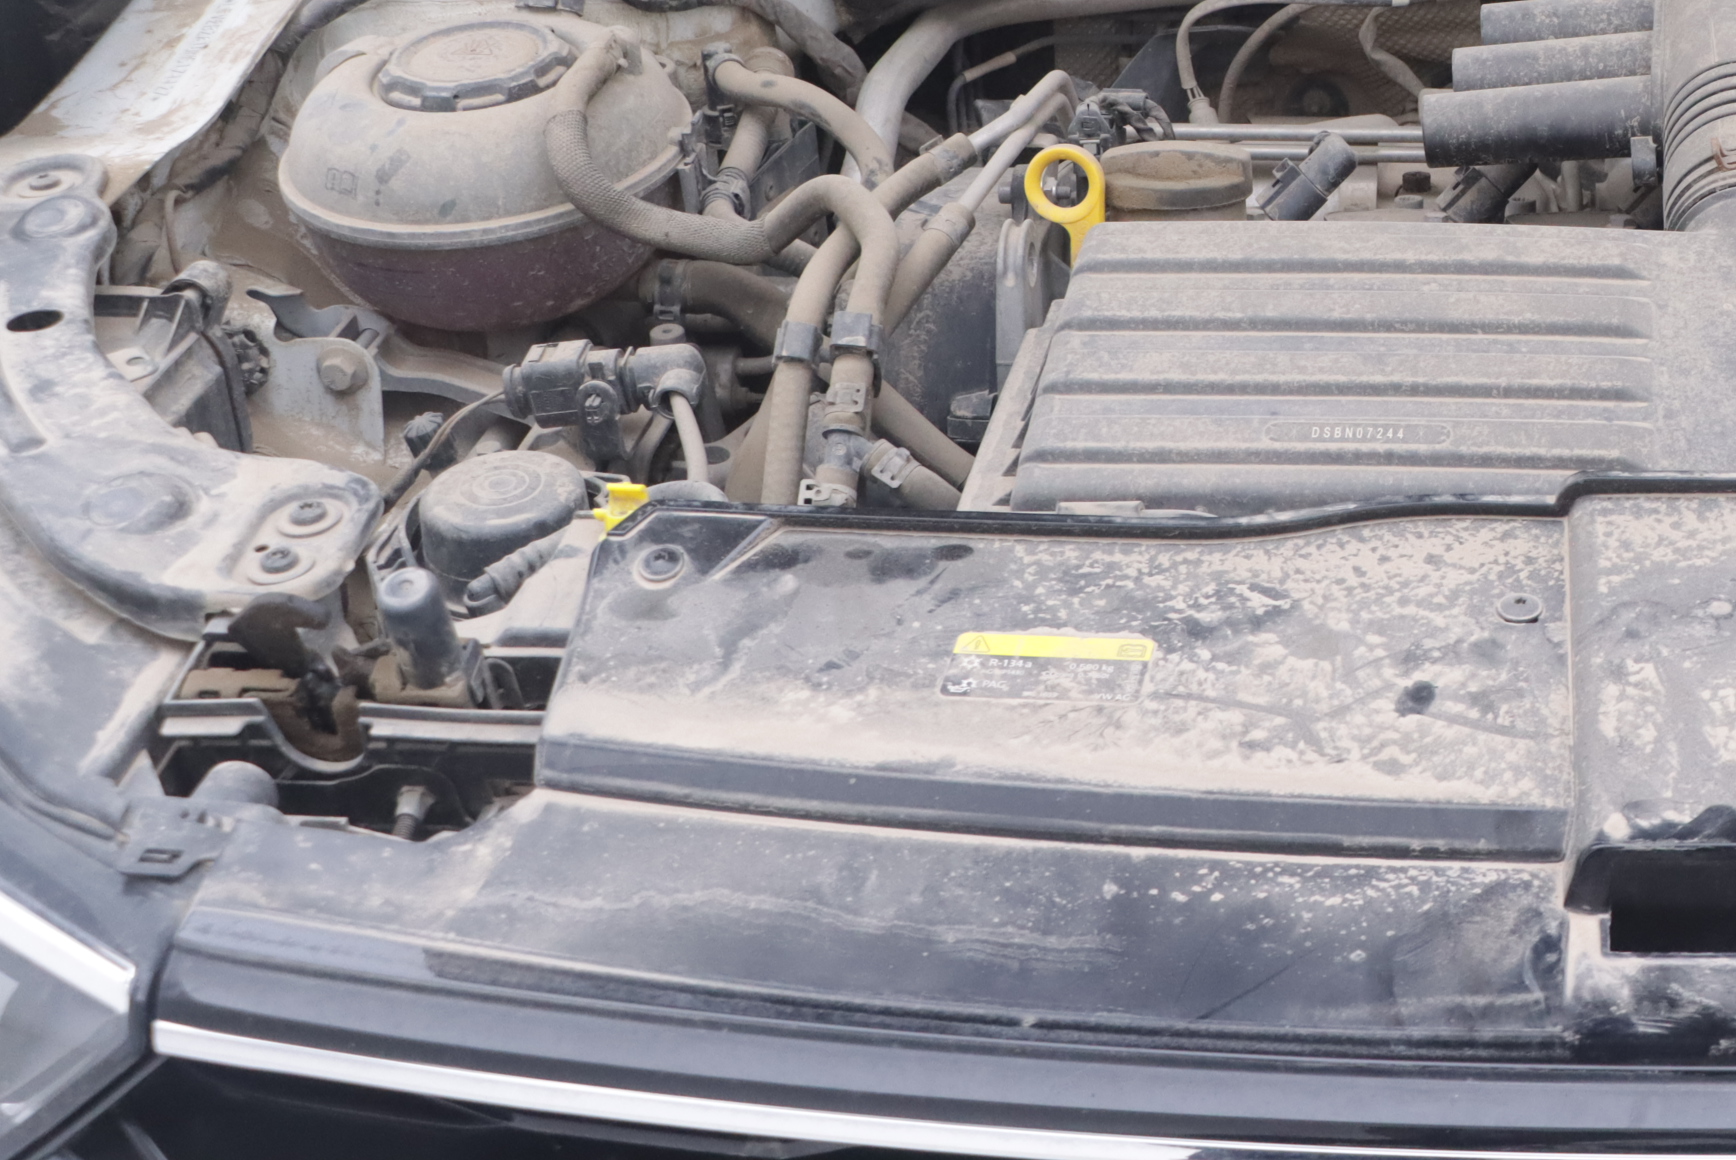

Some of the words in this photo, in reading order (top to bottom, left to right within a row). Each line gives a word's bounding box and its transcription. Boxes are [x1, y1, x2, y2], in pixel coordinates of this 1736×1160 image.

[1311, 426, 1405, 439] DSBN07244
[988, 658, 1033, 668] R-134a
[1101, 663, 1115, 674] kg
